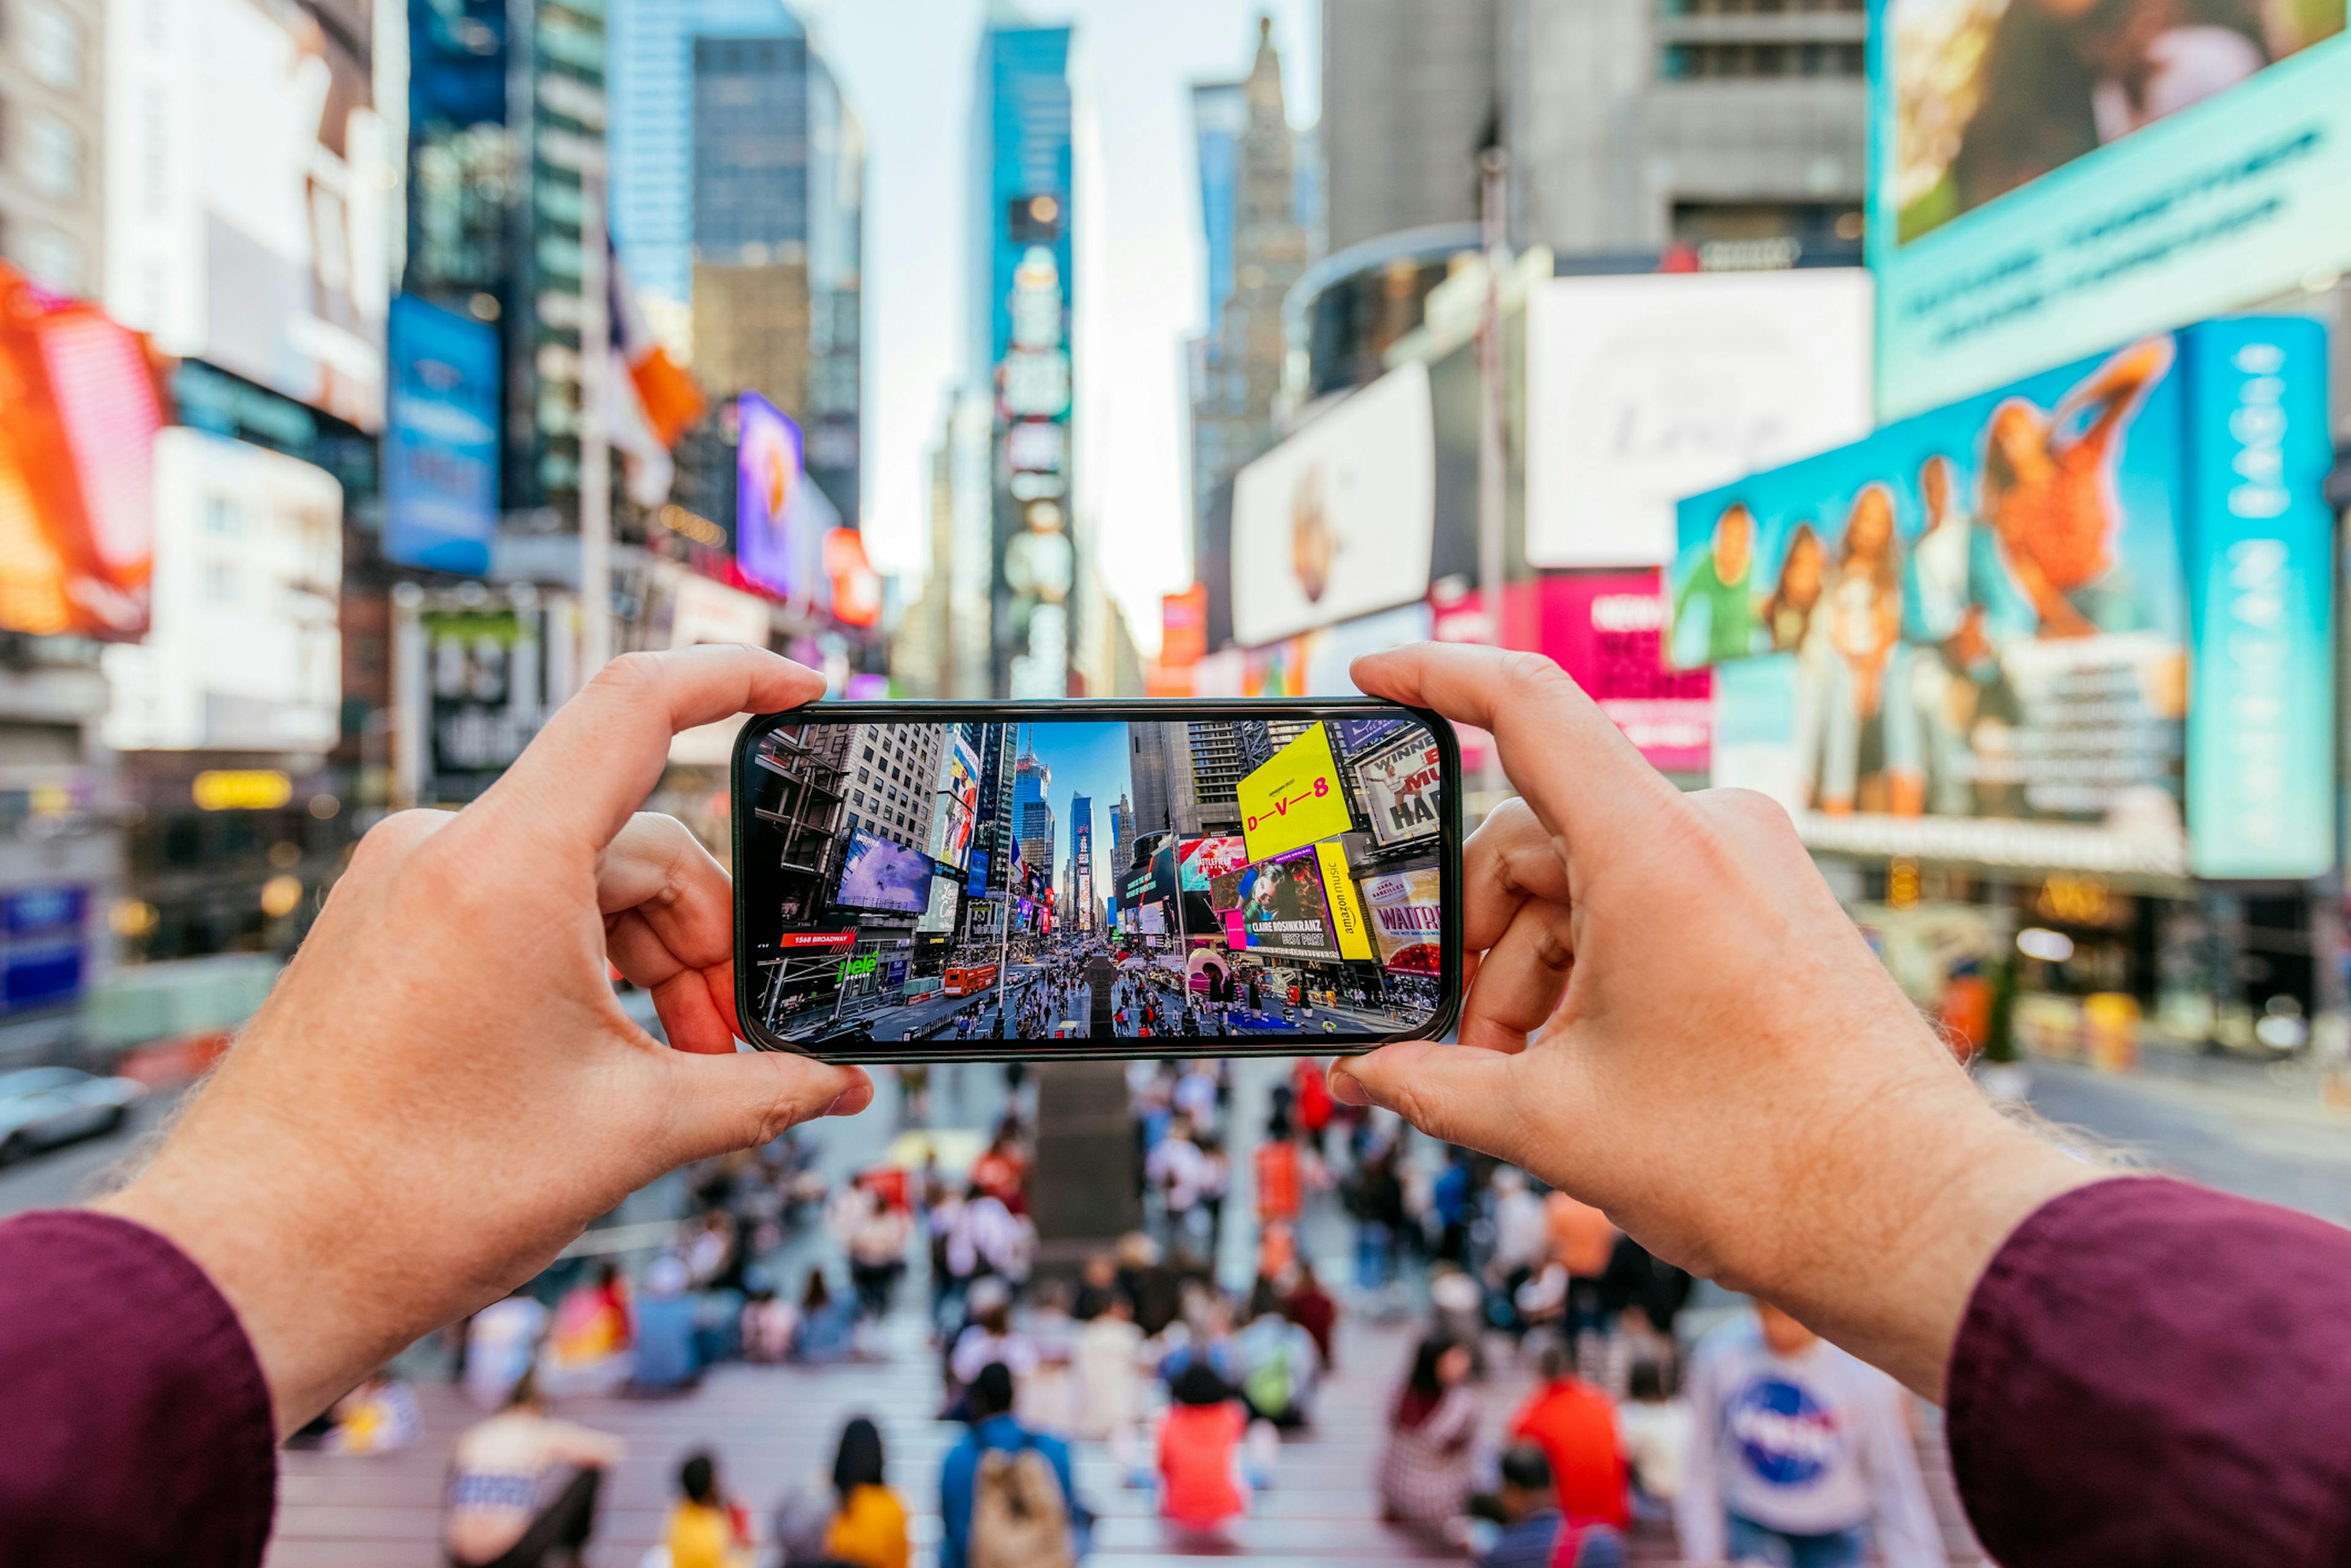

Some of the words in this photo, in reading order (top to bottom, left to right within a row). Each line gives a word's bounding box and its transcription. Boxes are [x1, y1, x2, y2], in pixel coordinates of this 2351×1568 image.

[1327, 862, 1343, 893] music
[1252, 921, 1273, 932] CLAIRE
[1336, 895, 1355, 934] amazon
